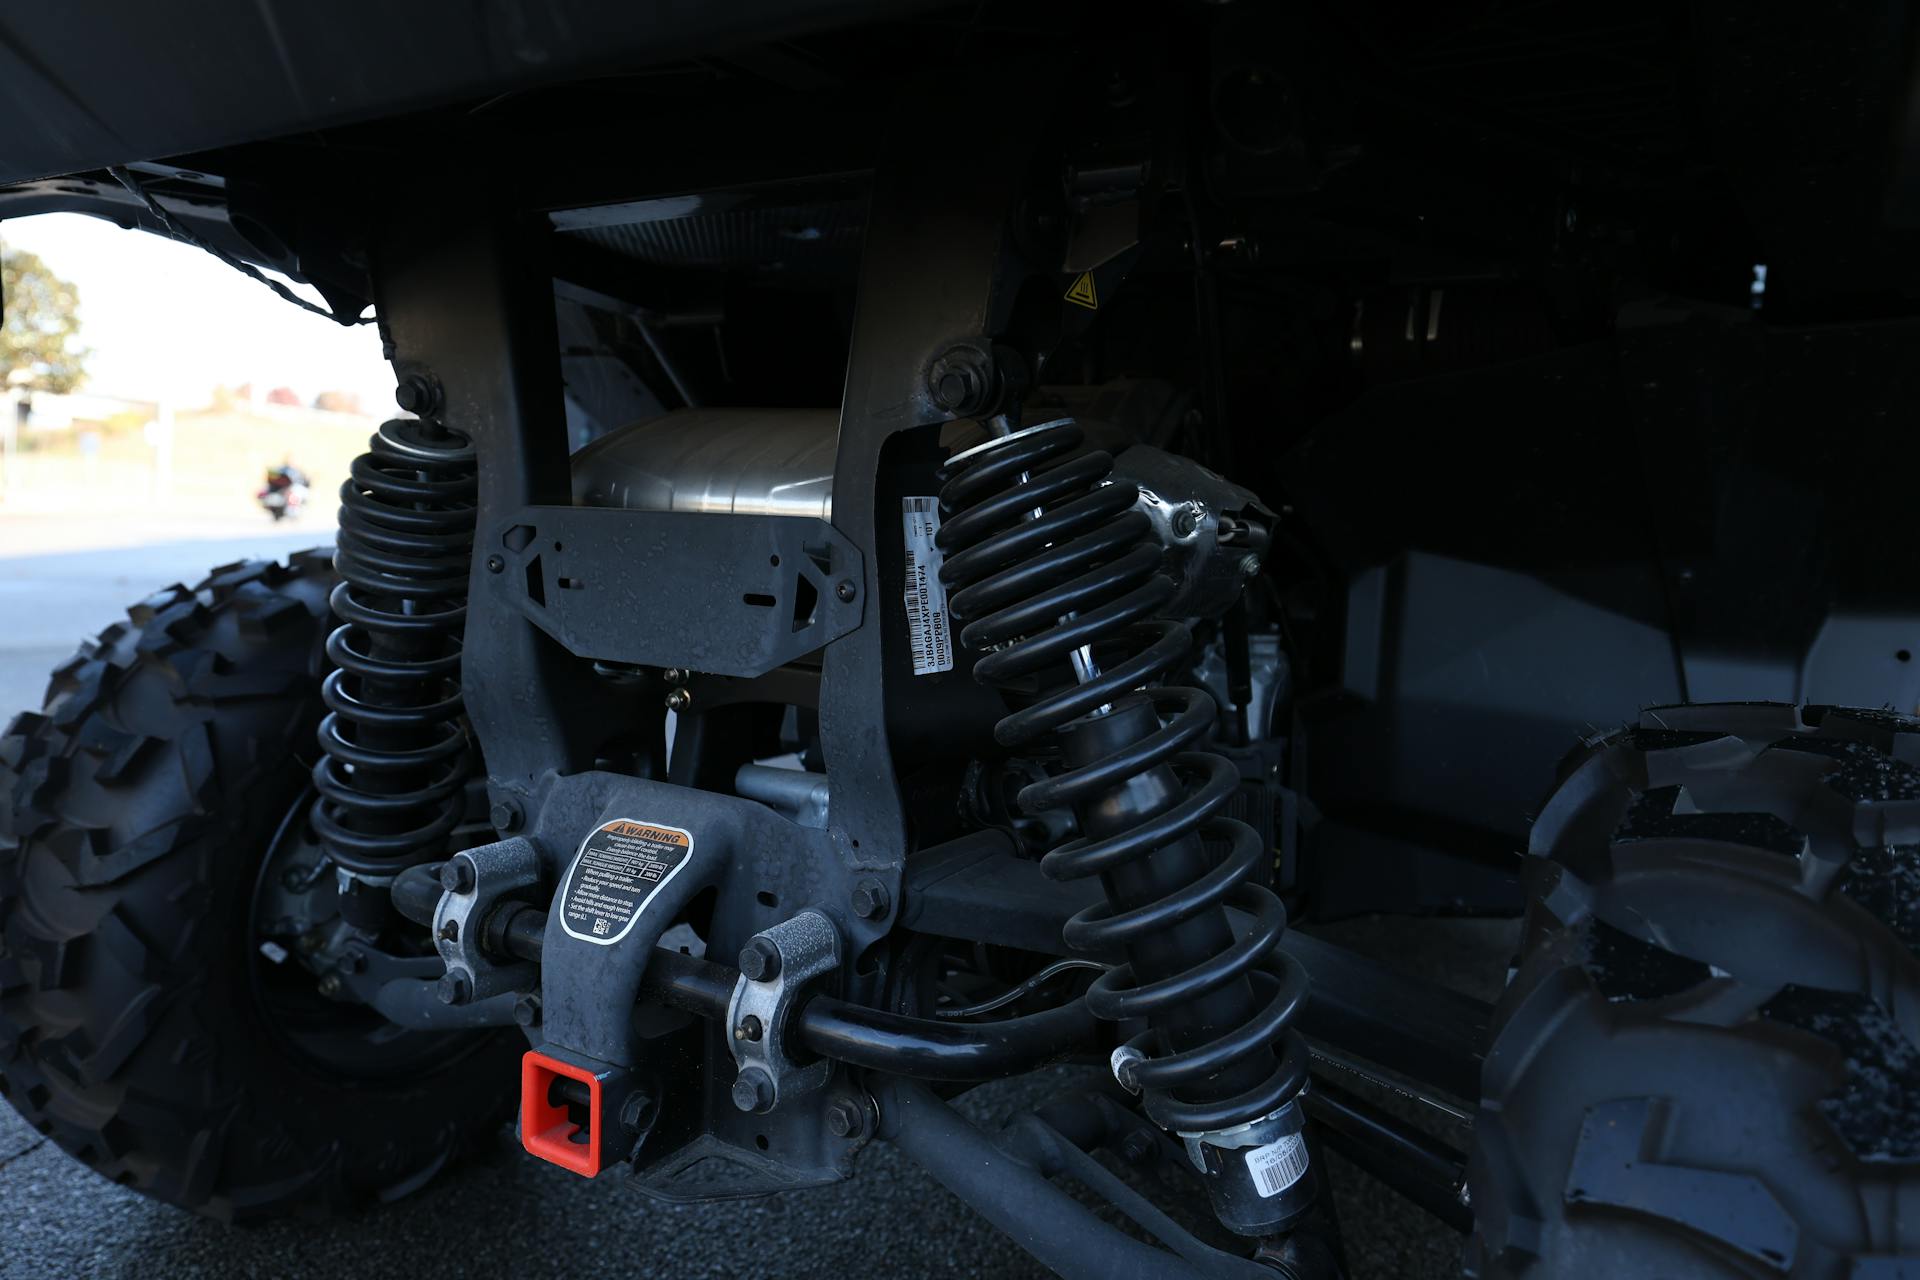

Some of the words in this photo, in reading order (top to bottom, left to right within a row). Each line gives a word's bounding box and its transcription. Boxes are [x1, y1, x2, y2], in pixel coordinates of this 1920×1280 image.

[925, 522, 933, 536] 101
[626, 826, 680, 843] WARNING
[598, 872, 614, 880] pulling
